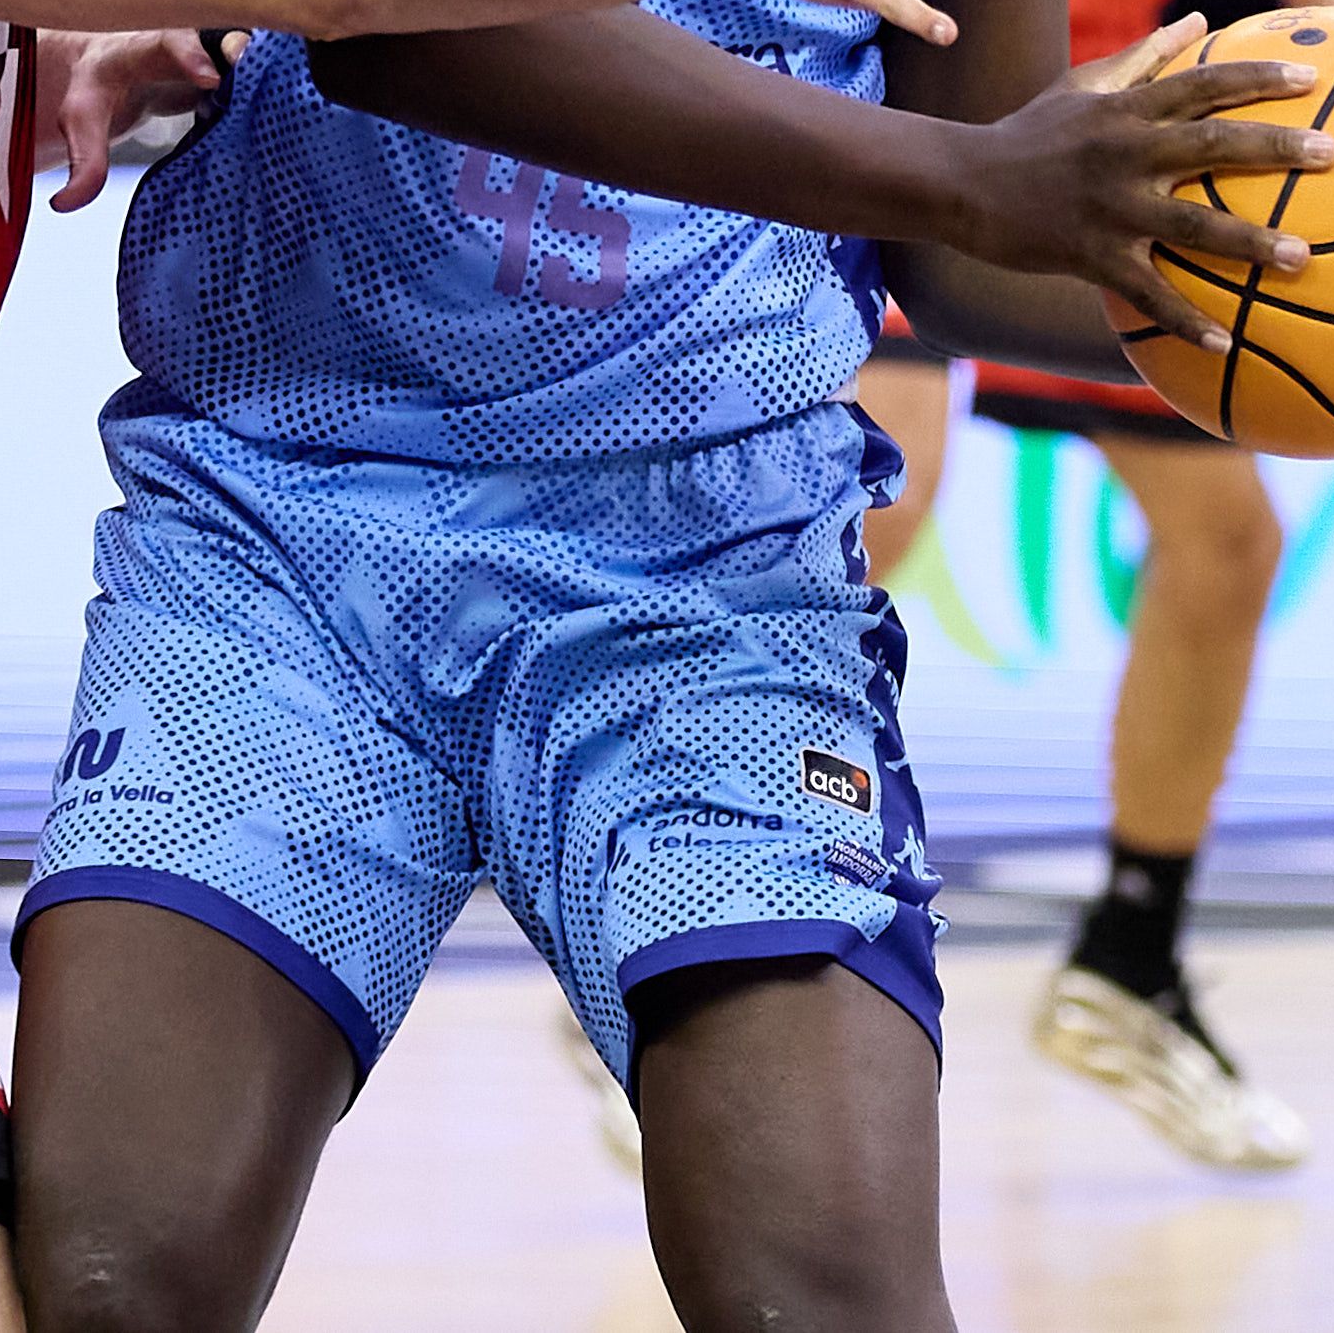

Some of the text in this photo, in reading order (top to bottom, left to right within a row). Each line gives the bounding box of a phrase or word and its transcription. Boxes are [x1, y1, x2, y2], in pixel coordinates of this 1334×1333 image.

[82, 789, 104, 806] la
[110, 784, 175, 805] Vella
[809, 770, 859, 804] acb
[651, 804, 784, 833] andorra
